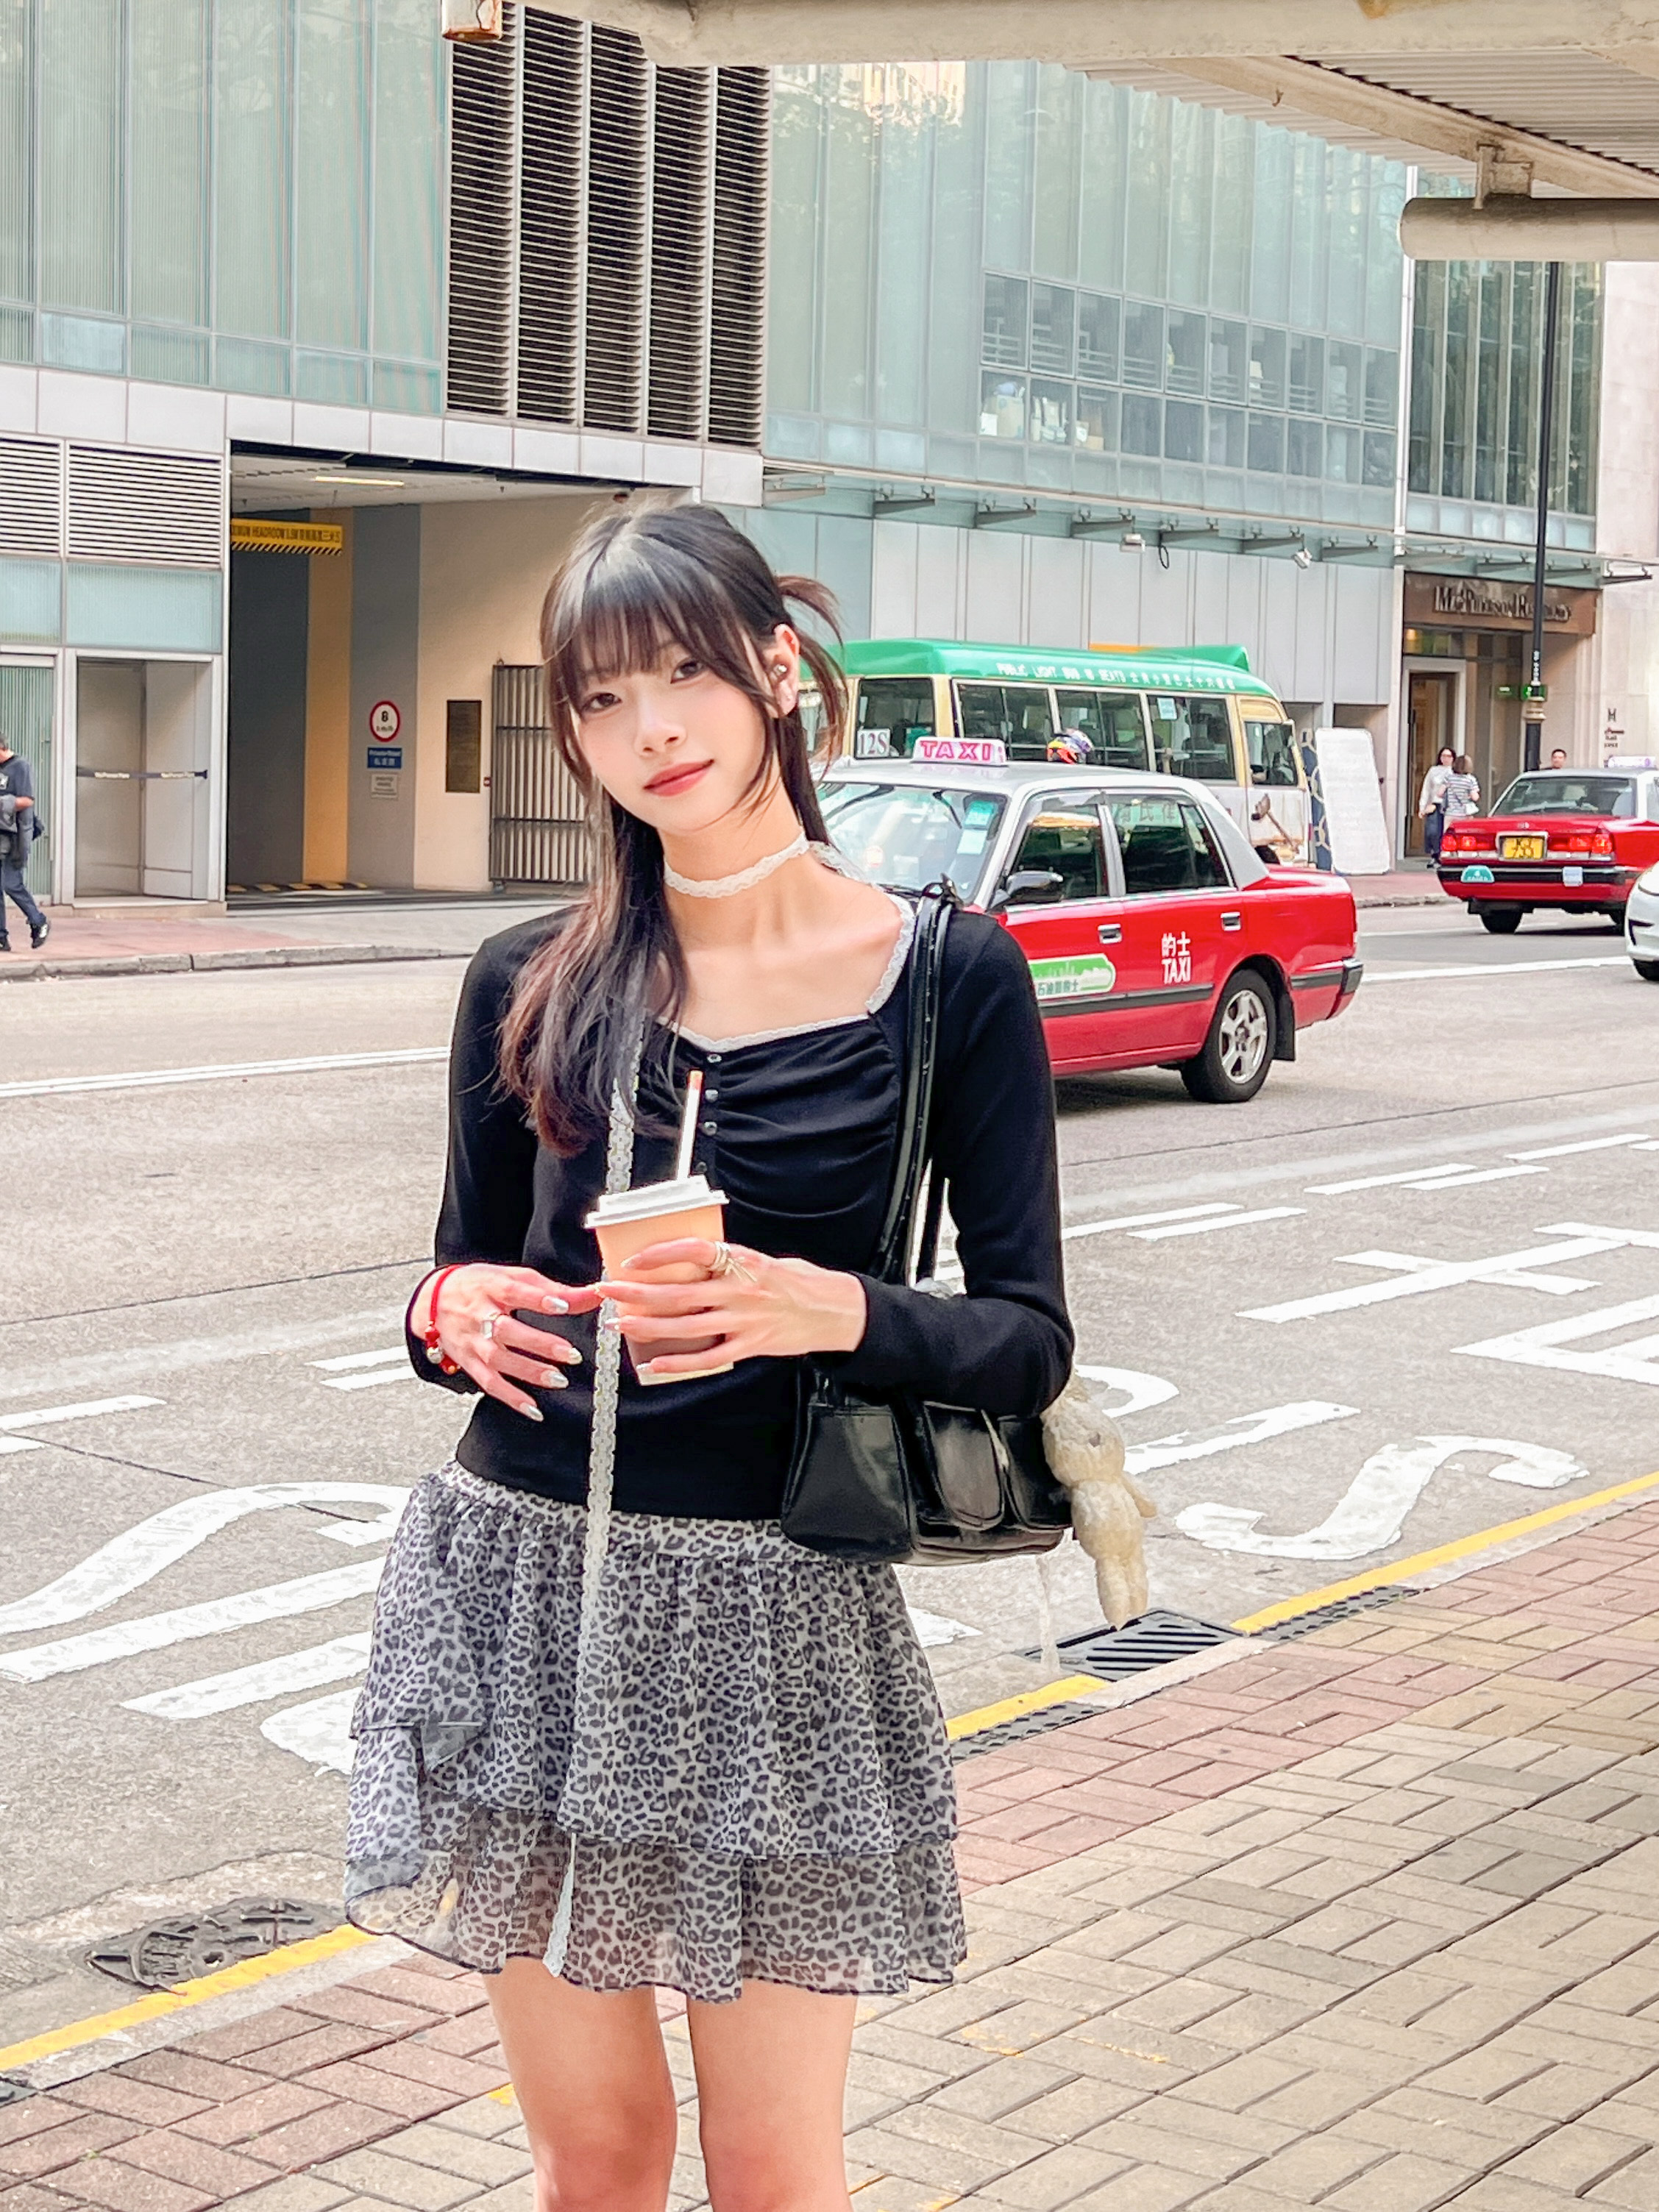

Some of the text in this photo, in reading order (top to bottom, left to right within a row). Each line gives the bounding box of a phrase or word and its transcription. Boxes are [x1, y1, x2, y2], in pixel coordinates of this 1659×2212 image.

[859, 731, 888, 756] 12S
[920, 740, 993, 761] TAXI
[1162, 931, 1191, 957] 的士
[1162, 956, 1191, 984] TAXI
